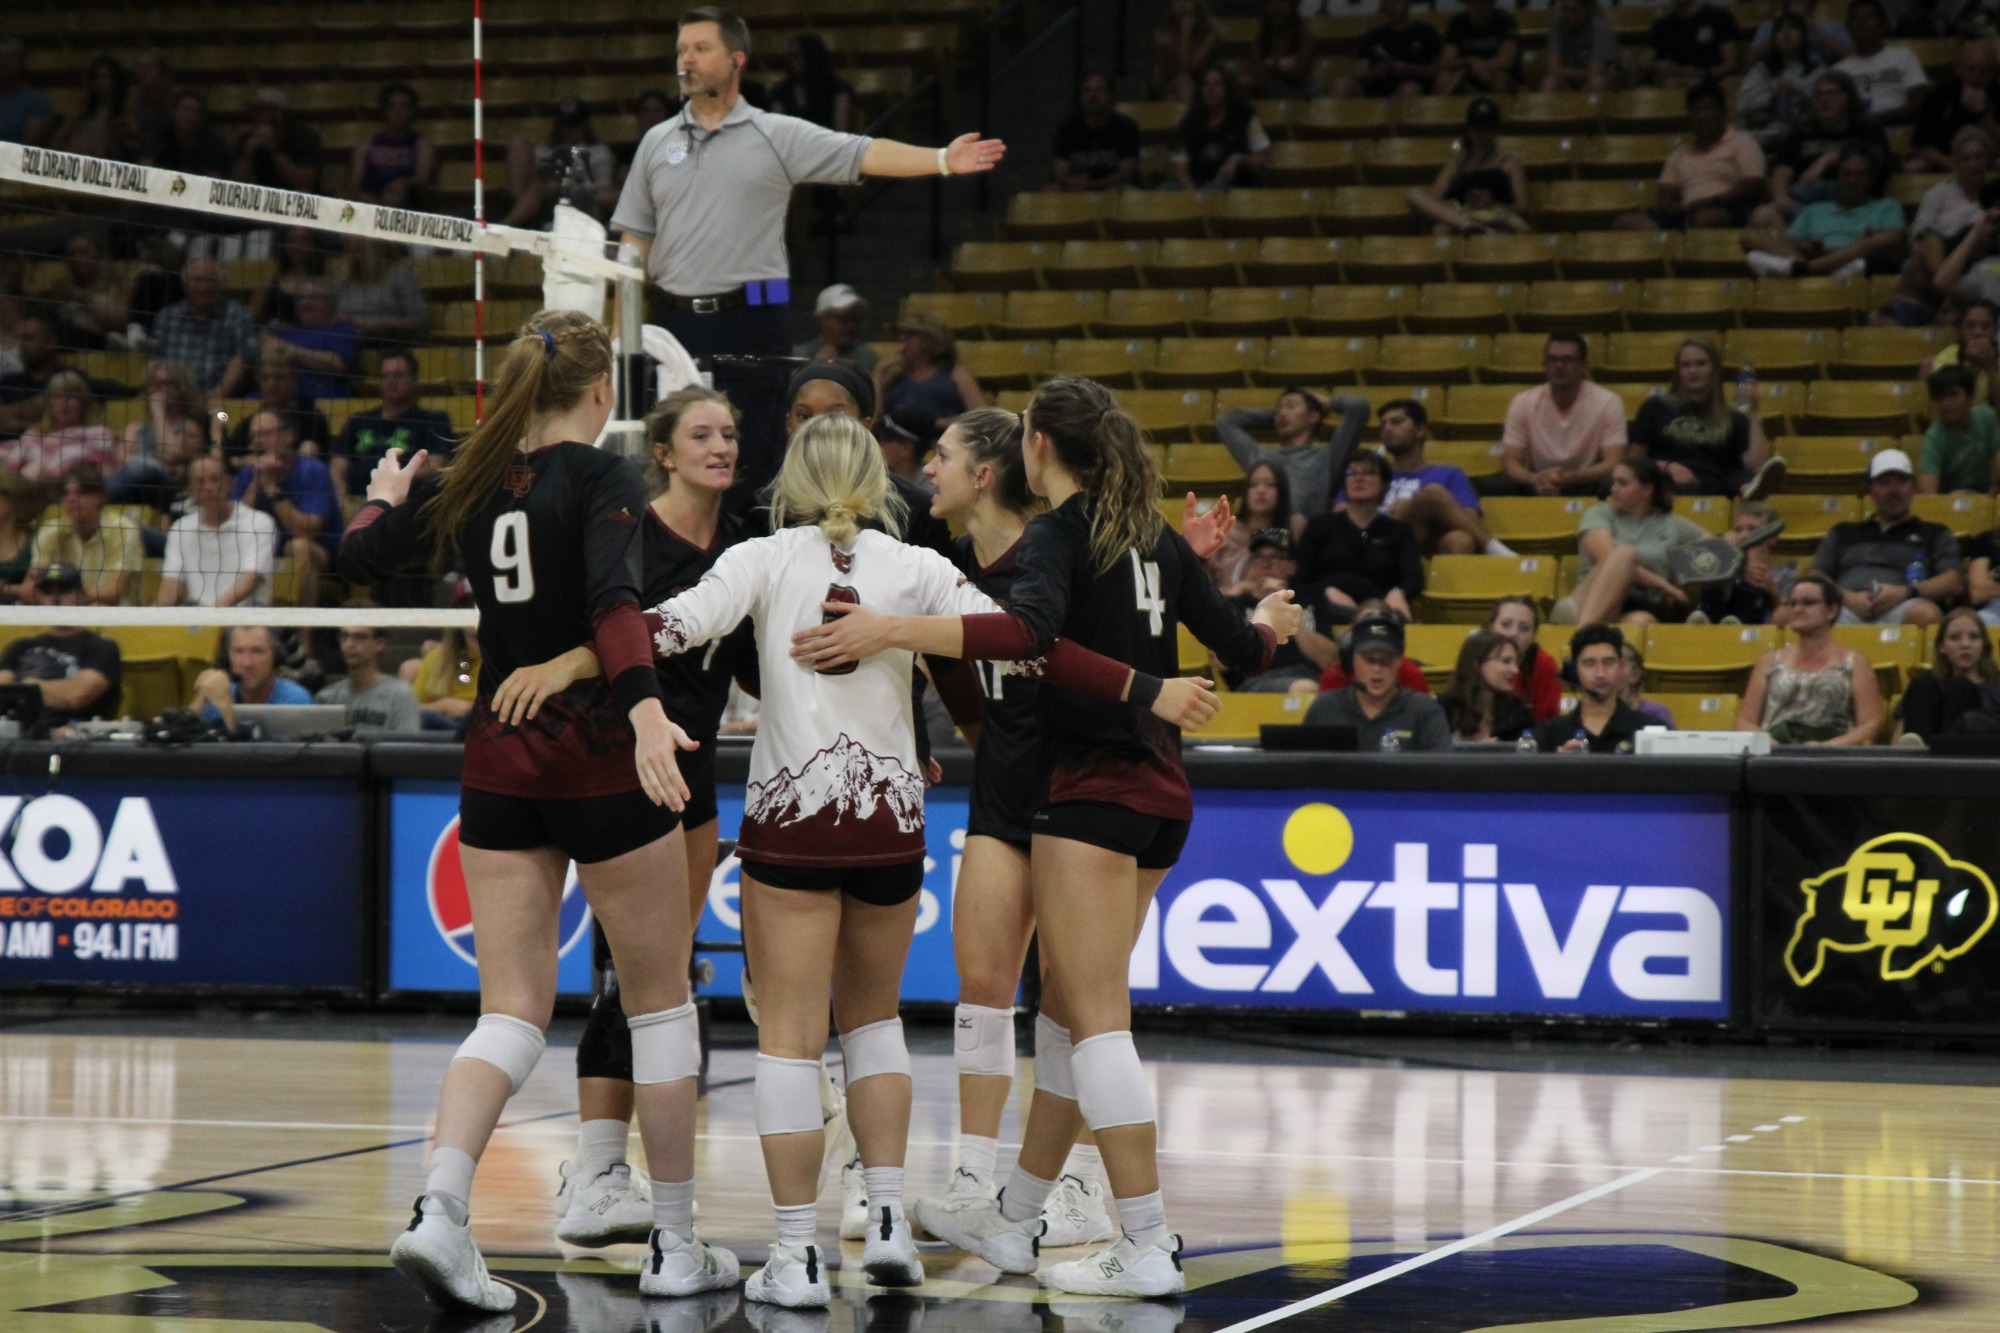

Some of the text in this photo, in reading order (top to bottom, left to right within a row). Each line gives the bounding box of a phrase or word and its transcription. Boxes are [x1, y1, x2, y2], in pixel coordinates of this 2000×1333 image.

[490, 509, 535, 604] 9
[1129, 546, 1167, 637] 4
[47, 898, 178, 918] COLORADO
[1842, 852, 1940, 946] CU
[1099, 1256, 1125, 1278] N
